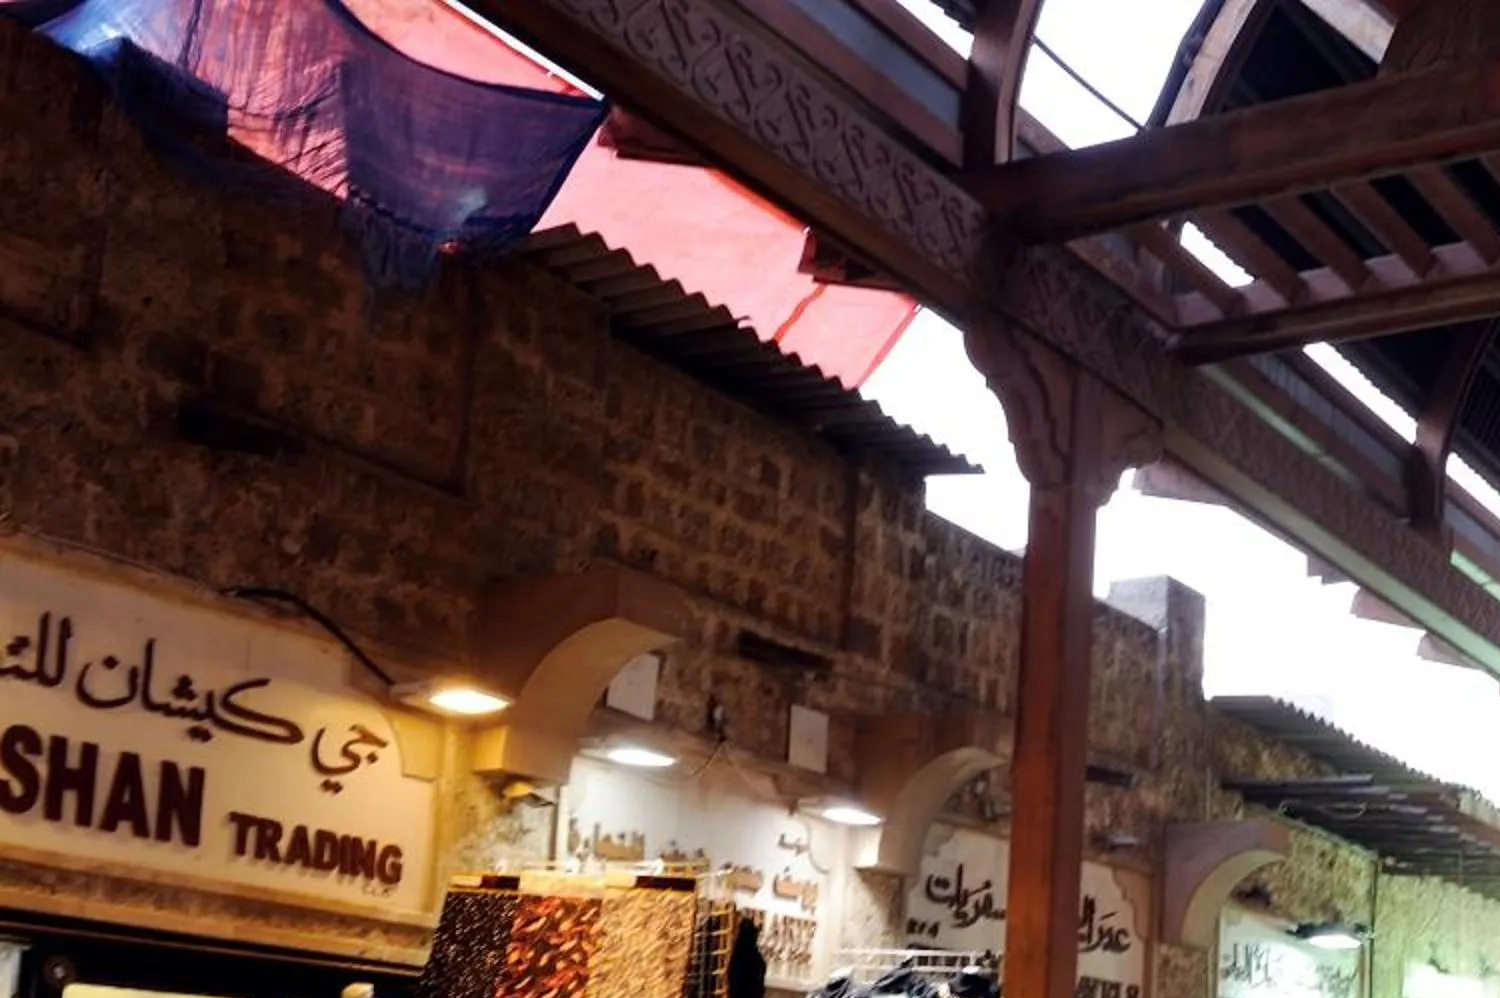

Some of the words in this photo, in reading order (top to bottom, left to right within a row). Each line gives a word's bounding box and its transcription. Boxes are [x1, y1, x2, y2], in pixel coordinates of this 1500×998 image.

[76, 637, 304, 744] كيشان
[311, 724, 388, 794] جي
[228, 811, 403, 884] TRADING
